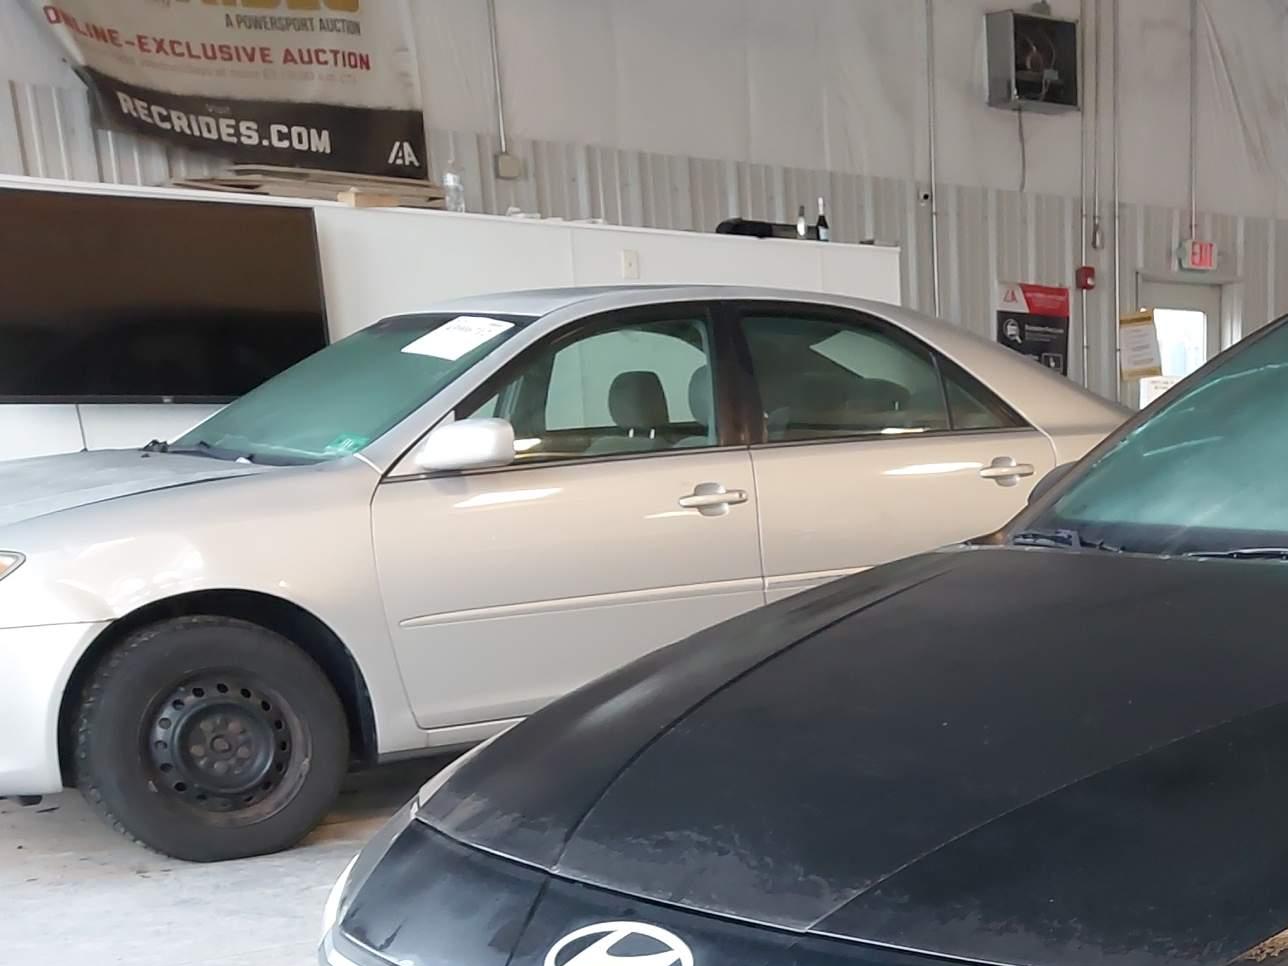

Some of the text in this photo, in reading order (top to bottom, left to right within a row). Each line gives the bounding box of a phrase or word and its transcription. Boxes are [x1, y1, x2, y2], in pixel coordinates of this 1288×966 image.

[43, 5, 371, 71] ONLINE-EXCLUSIVE AUCTION
[225, 14, 361, 36] A POWERSPORT AUCTION
[116, 91, 332, 154] RECRIDES.COM
